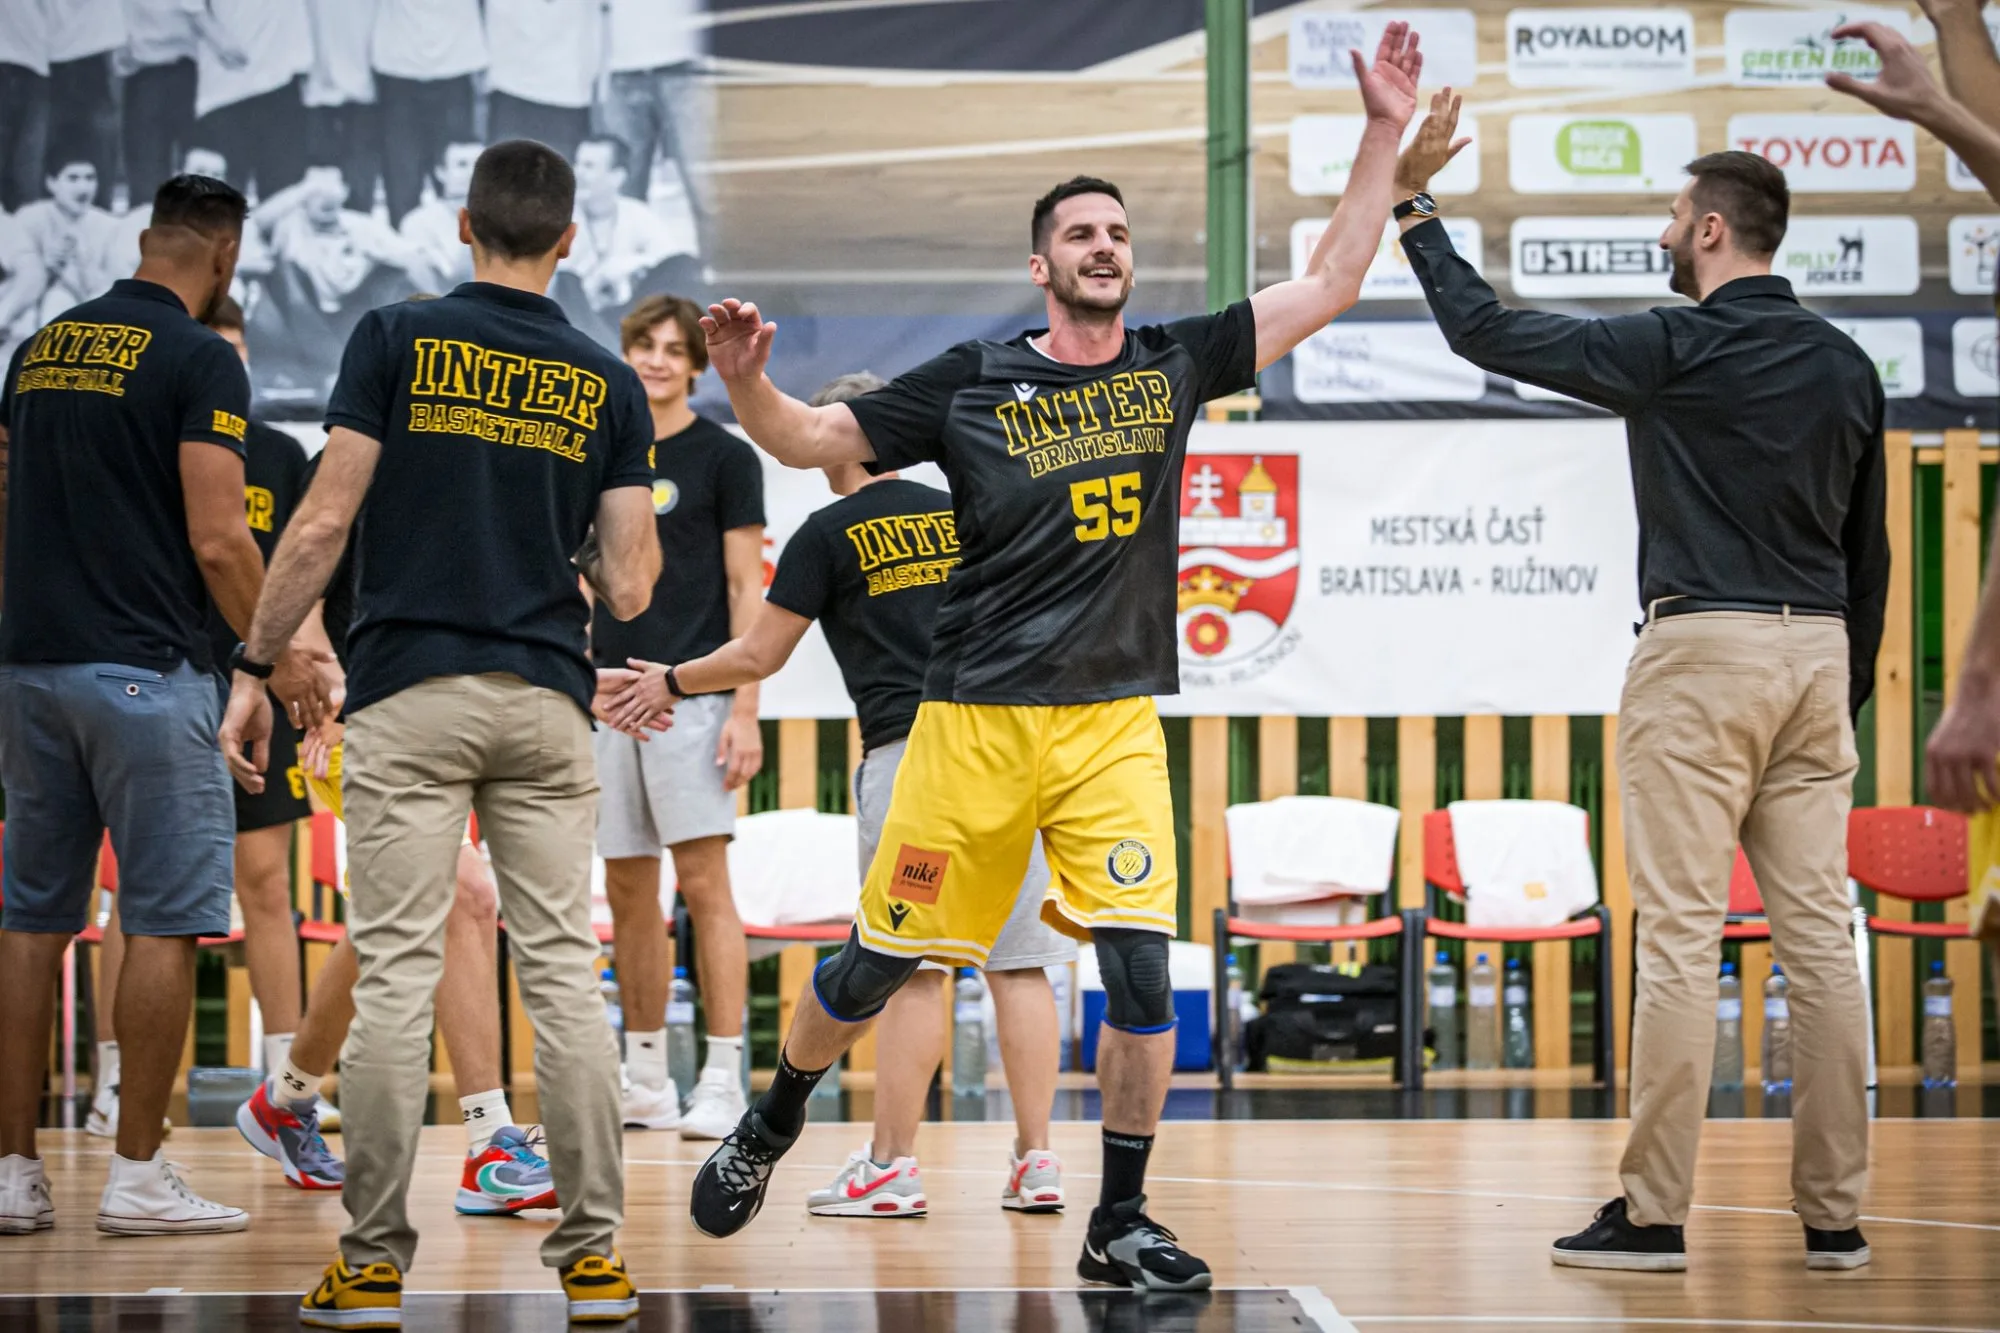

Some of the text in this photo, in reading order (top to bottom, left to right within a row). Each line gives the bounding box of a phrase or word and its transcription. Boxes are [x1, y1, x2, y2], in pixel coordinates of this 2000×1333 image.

[1515, 26, 1687, 55] ROYALDOM
[1741, 50, 1825, 68] GREEN
[1737, 138, 1906, 168] TOYOTA
[1806, 270, 1863, 283] JOKER
[23, 321, 152, 371] INTER
[411, 338, 607, 431] INTER
[996, 370, 1174, 456] INTER
[408, 403, 587, 463] BASKETBALL
[1026, 427, 1166, 478] BRATISLAVA
[1069, 471, 1142, 543] 55
[1370, 507, 1476, 546] MESTSKÁ
[845, 510, 961, 572] INTE
[866, 557, 963, 596] BASKET
[1319, 565, 1463, 596] BRATISLAVA
[1491, 556, 1599, 596] RUŽINOV
[902, 862, 939, 883] niké
[283, 1071, 306, 1092] 23
